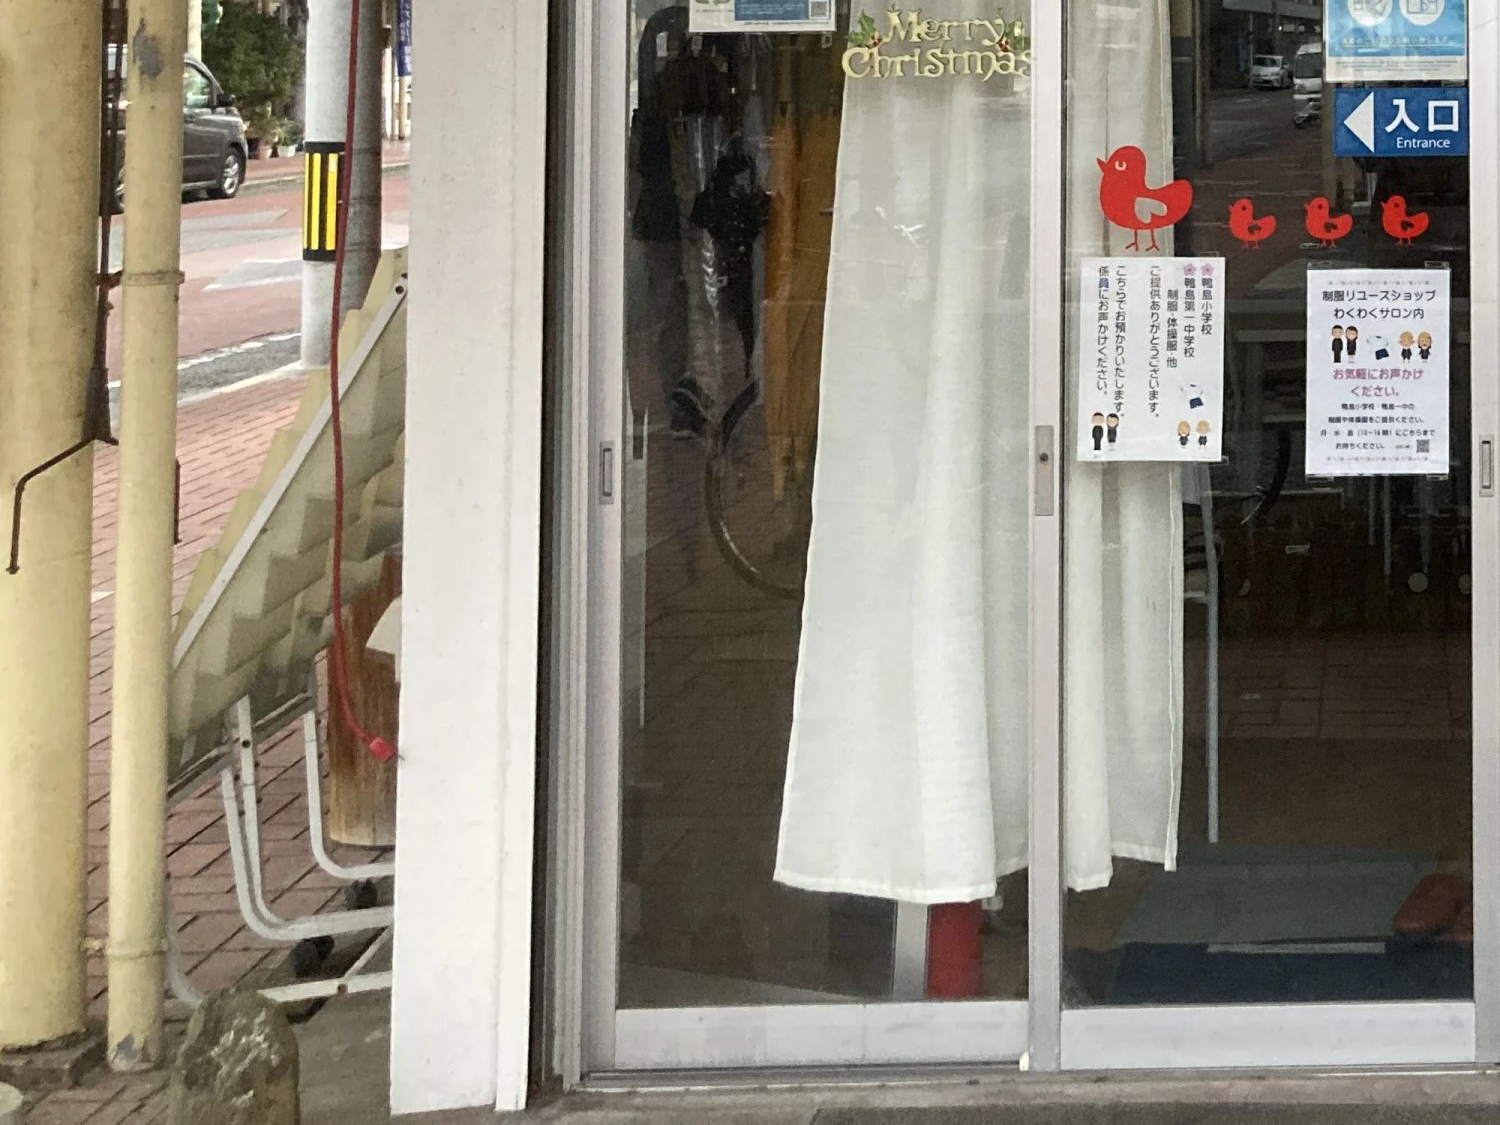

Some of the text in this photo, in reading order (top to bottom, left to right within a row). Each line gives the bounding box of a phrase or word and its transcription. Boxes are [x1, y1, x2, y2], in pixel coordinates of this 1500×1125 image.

[882, 9, 1006, 46] Merry
[1385, 98, 1459, 133] 入口
[1396, 137, 1451, 148] Entrance
[1201, 278, 1213, 335] 鴨島小学校
[1322, 290, 1436, 302] 制服リユースショップ
[1334, 308, 1425, 320] わくわくサロン内
[1097, 266, 1109, 395] 係員にお声かけください。
[1184, 278, 1196, 358] 鴨島第一中学校
[1114, 265, 1126, 417] こちらでお預かりいたします。
[1149, 265, 1161, 417] ご提供ありがとうございます。
[1333, 369, 1424, 380] お気軽にお声かけ
[1351, 386, 1400, 397] ください。
